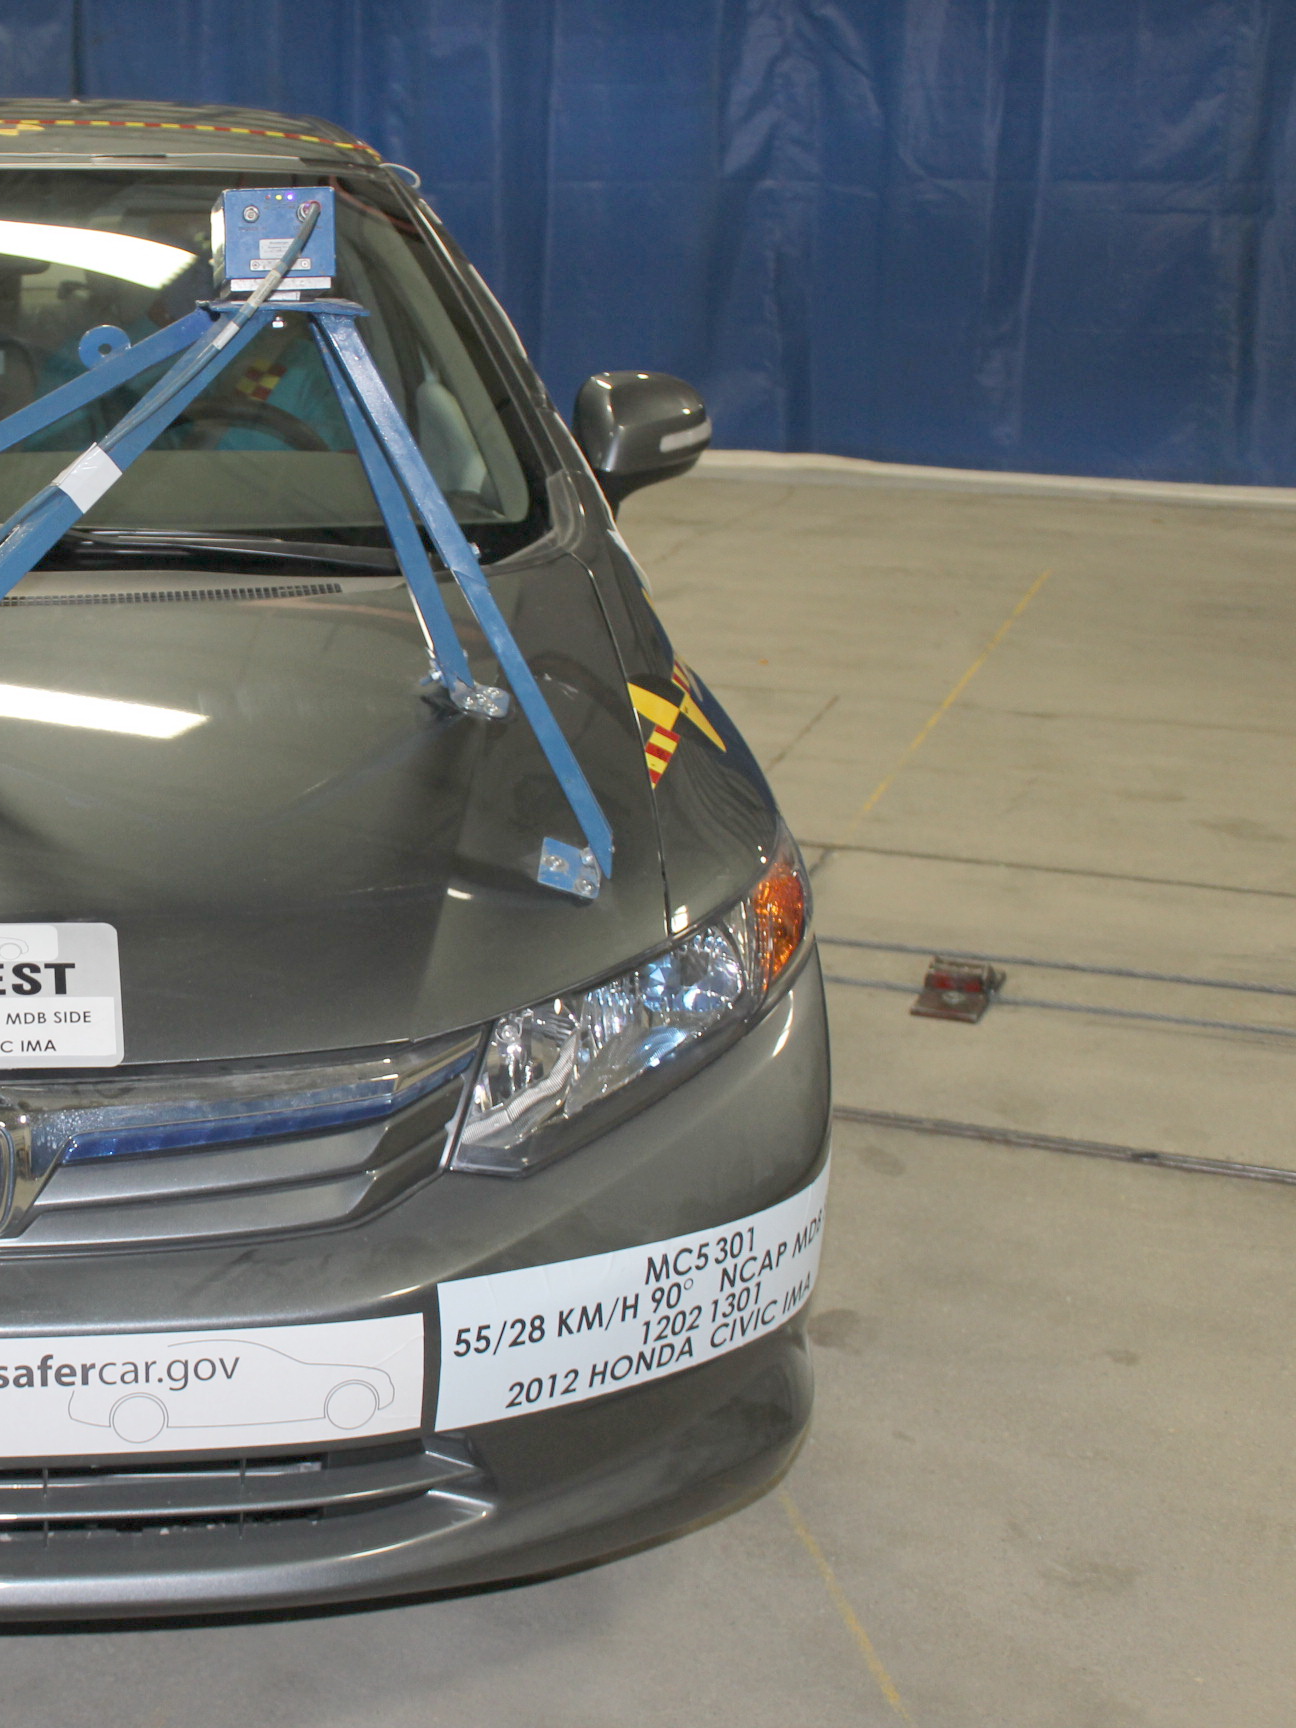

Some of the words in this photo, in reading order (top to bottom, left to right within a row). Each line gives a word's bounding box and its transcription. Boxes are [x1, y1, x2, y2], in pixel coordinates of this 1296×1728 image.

[6, 1011, 47, 1026] MDB
[53, 1010, 92, 1025] SIDE
[20, 1039, 57, 1053] IMA
[644, 1226, 755, 1285] MC5301
[453, 1314, 546, 1358] 55/28
[556, 1292, 640, 1338] KM/H
[719, 1241, 788, 1293] NCAP
[505, 1369, 579, 1409] 2012
[588, 1336, 694, 1388] HONDA
[709, 1299, 778, 1349] CIVIC
[782, 1271, 811, 1314] IMA
